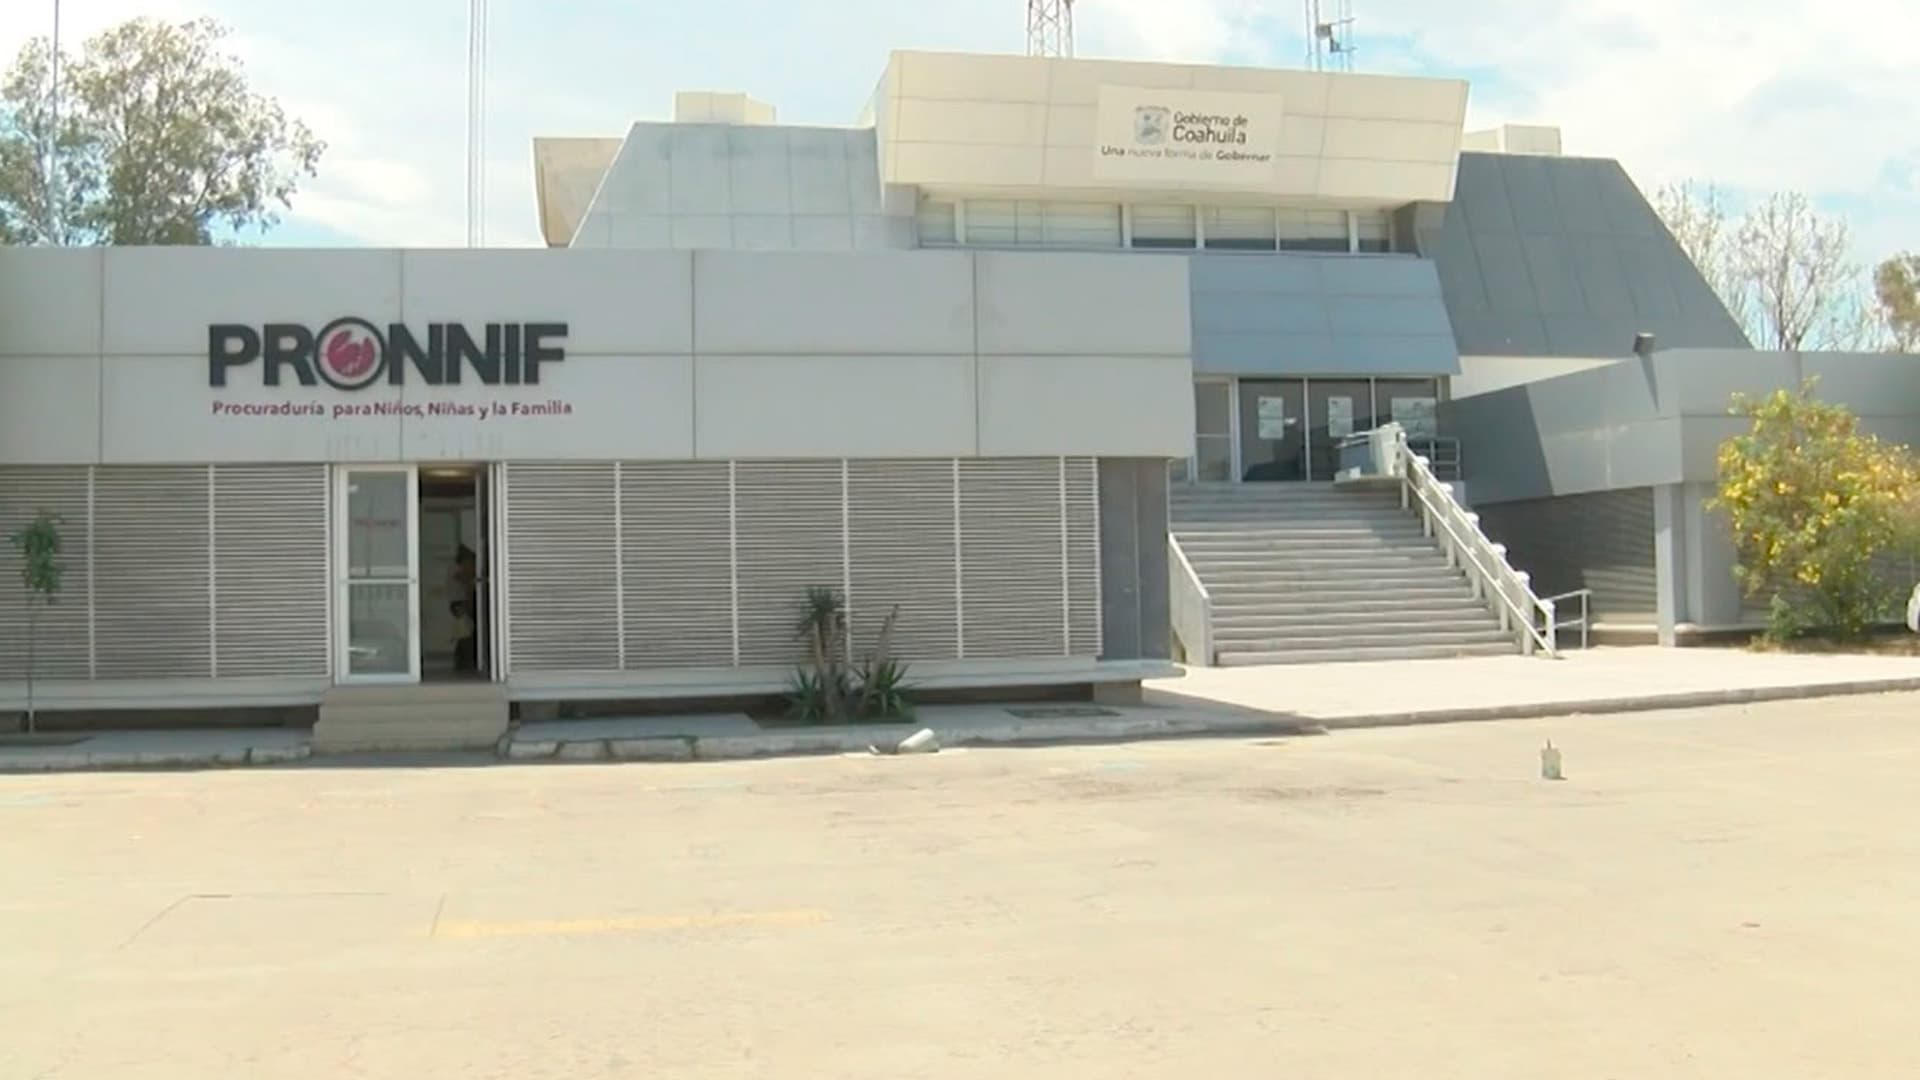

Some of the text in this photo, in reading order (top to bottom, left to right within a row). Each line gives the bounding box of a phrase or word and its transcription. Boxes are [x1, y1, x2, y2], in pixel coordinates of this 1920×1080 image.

[1174, 111, 1248, 127] Gobierno de
[1173, 125, 1246, 144] Coahuila
[1101, 146, 1125, 156] Una
[208, 316, 569, 391] PRONNIF
[212, 401, 325, 416] Procuraduría
[333, 403, 371, 419] para
[428, 402, 475, 416] Niñas
[478, 406, 489, 420] y
[492, 402, 507, 415] la
[511, 401, 572, 415] Familia
